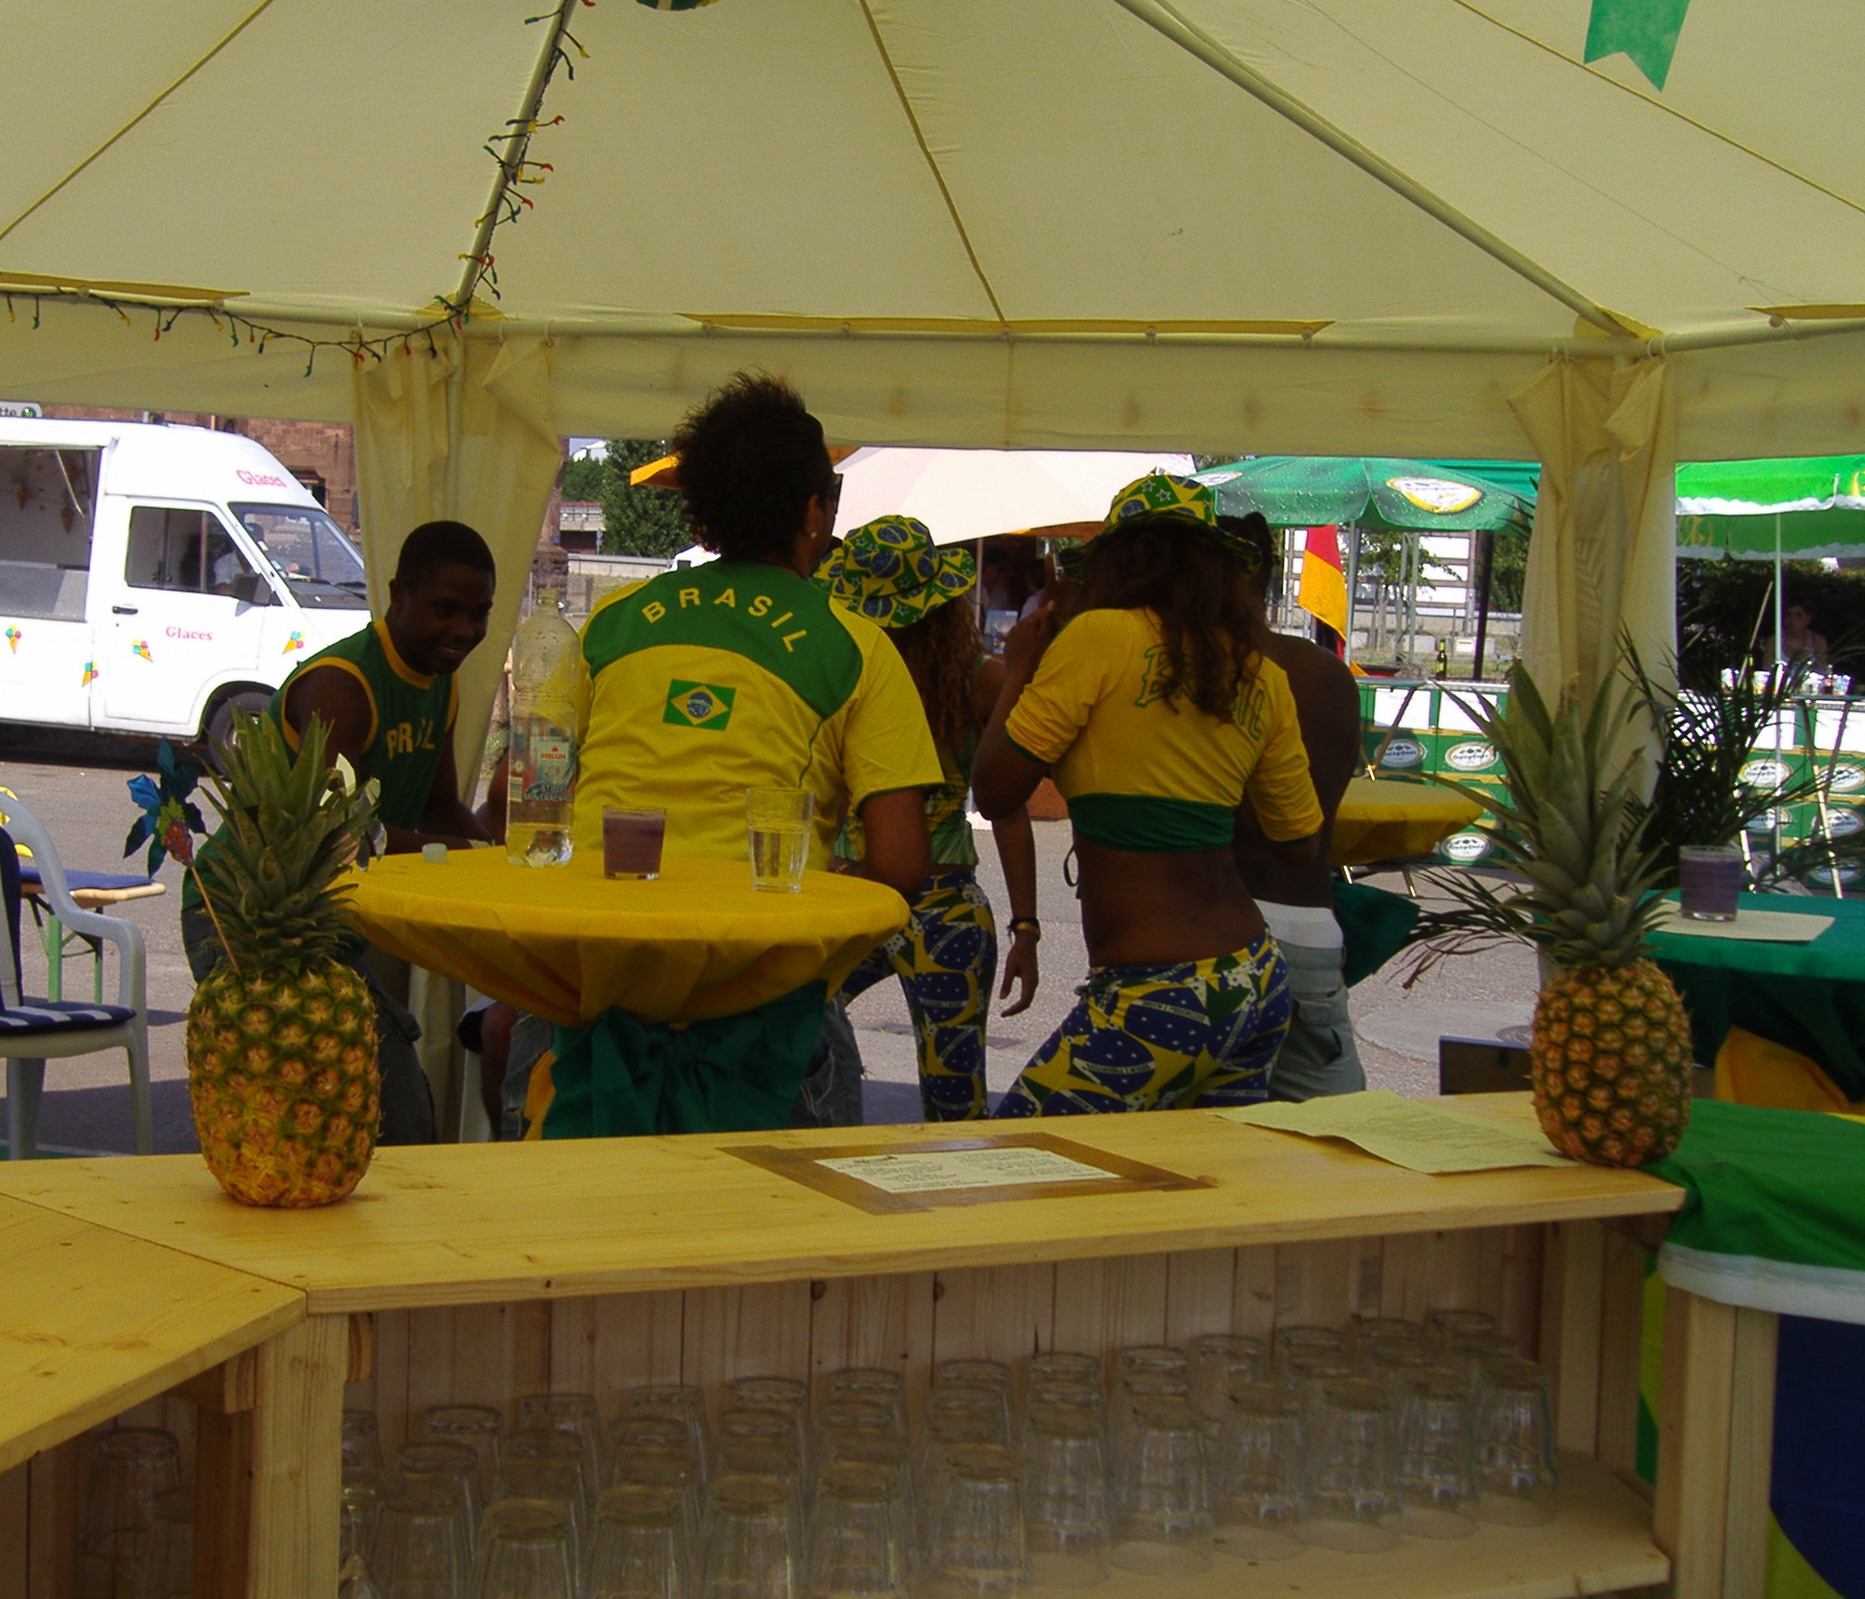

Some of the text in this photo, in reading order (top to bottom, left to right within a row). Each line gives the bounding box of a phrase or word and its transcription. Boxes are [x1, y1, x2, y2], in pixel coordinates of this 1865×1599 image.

[236, 470, 287, 488] Glaces
[641, 587, 808, 653] BRASIL
[165, 626, 213, 641] Glaces
